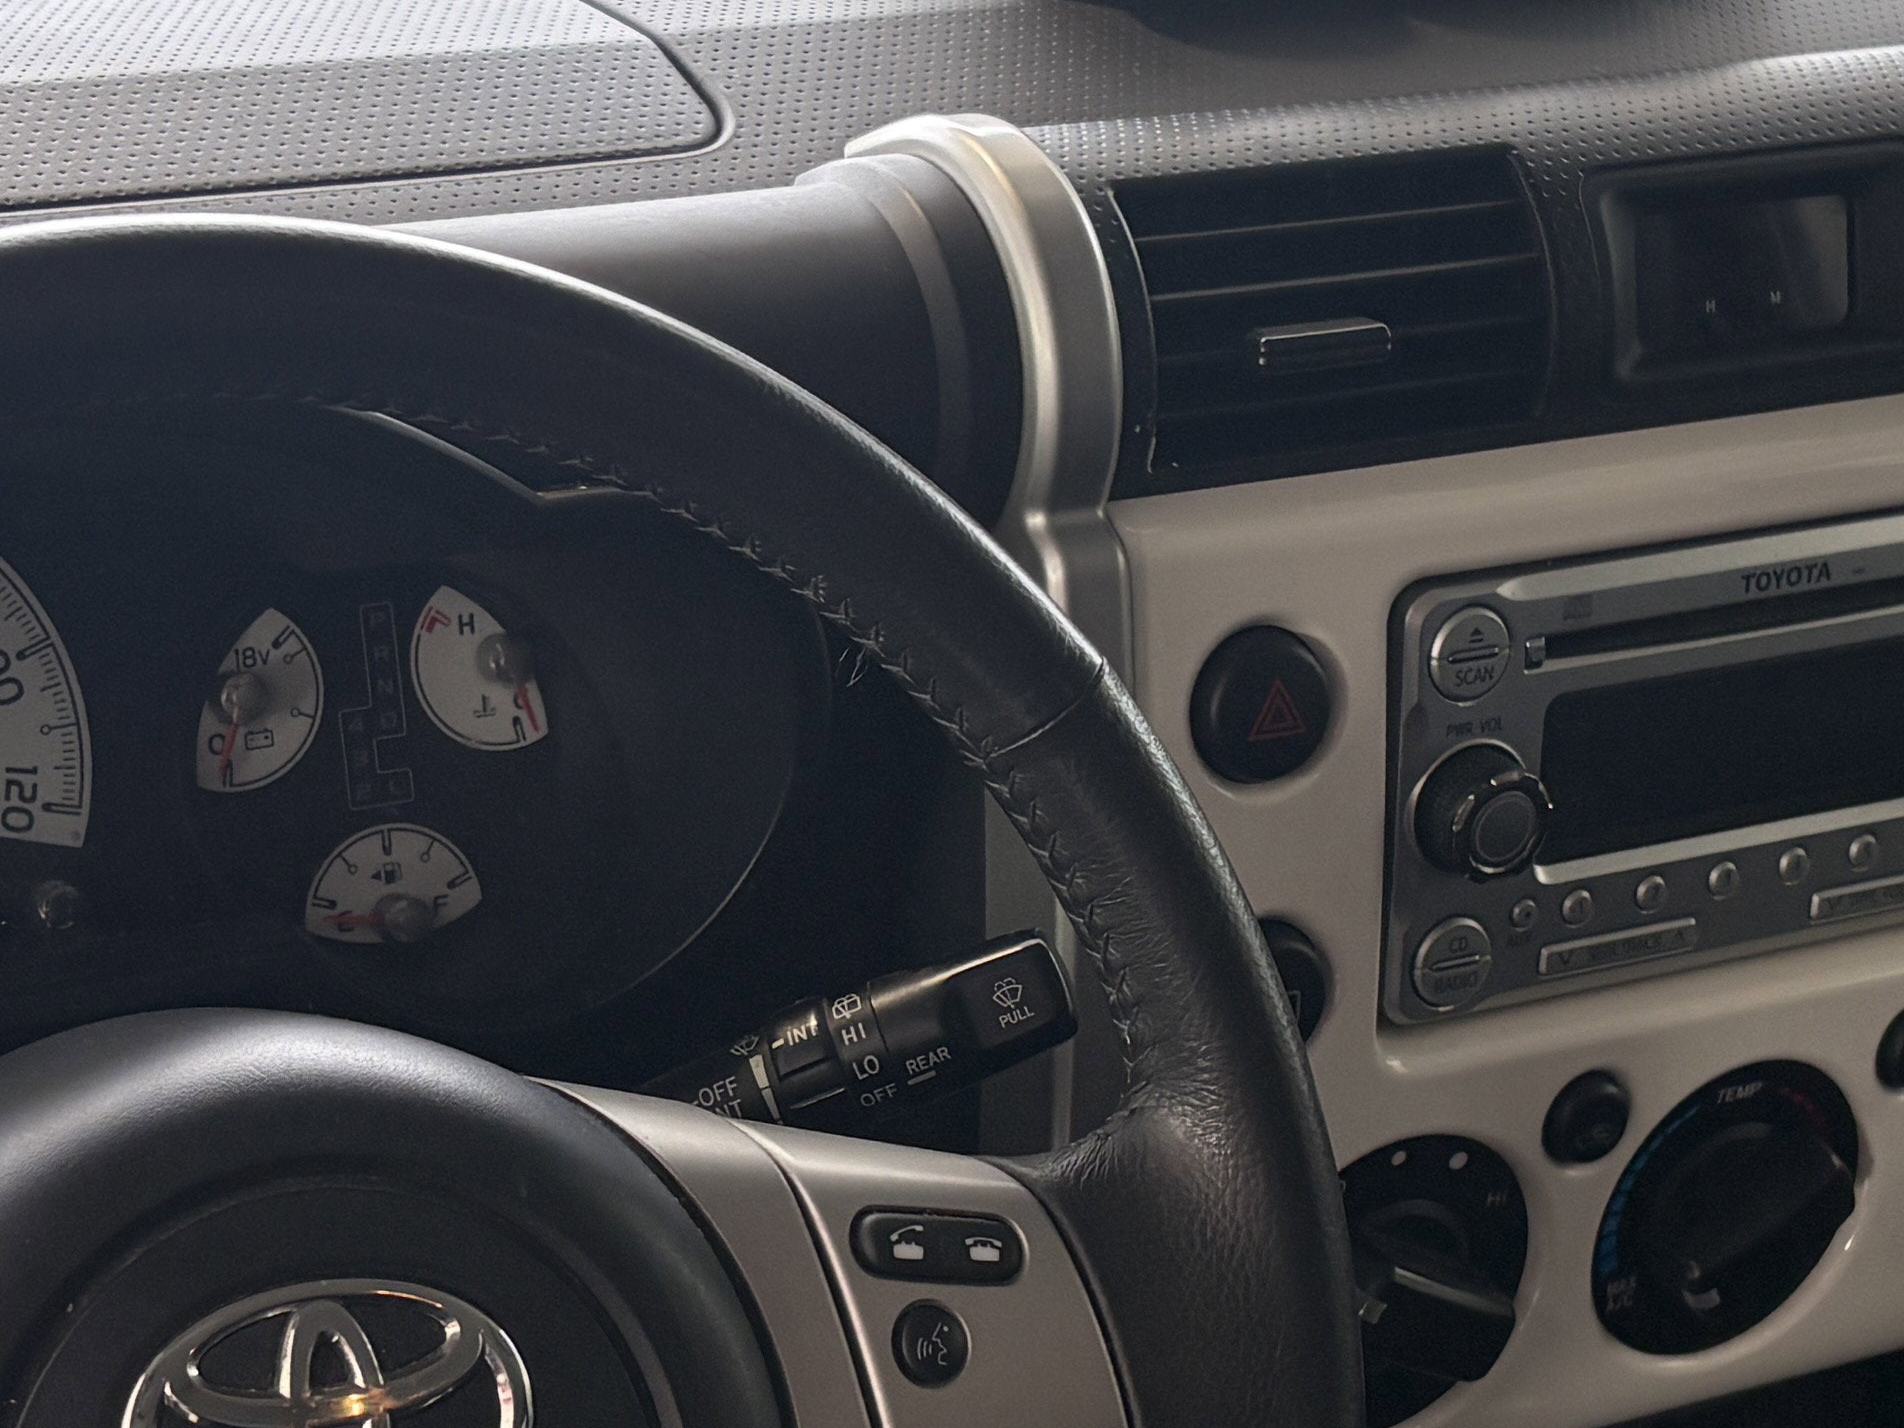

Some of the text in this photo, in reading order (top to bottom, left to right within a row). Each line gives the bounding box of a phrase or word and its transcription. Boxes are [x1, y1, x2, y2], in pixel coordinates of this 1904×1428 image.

[1741, 561, 1831, 594] TOYOTA
[457, 614, 476, 635] H
[1453, 665, 1495, 688] SCAN
[0, 765, 39, 833] 120
[1448, 936, 1469, 954] CD
[998, 1007, 1035, 1028] PULL
[786, 1021, 819, 1047] INT
[841, 1022, 867, 1046] HI
[852, 1055, 880, 1081] LO
[905, 1046, 951, 1075] REAR
[698, 1075, 737, 1108] OFF
[860, 1083, 897, 1108] OFF
